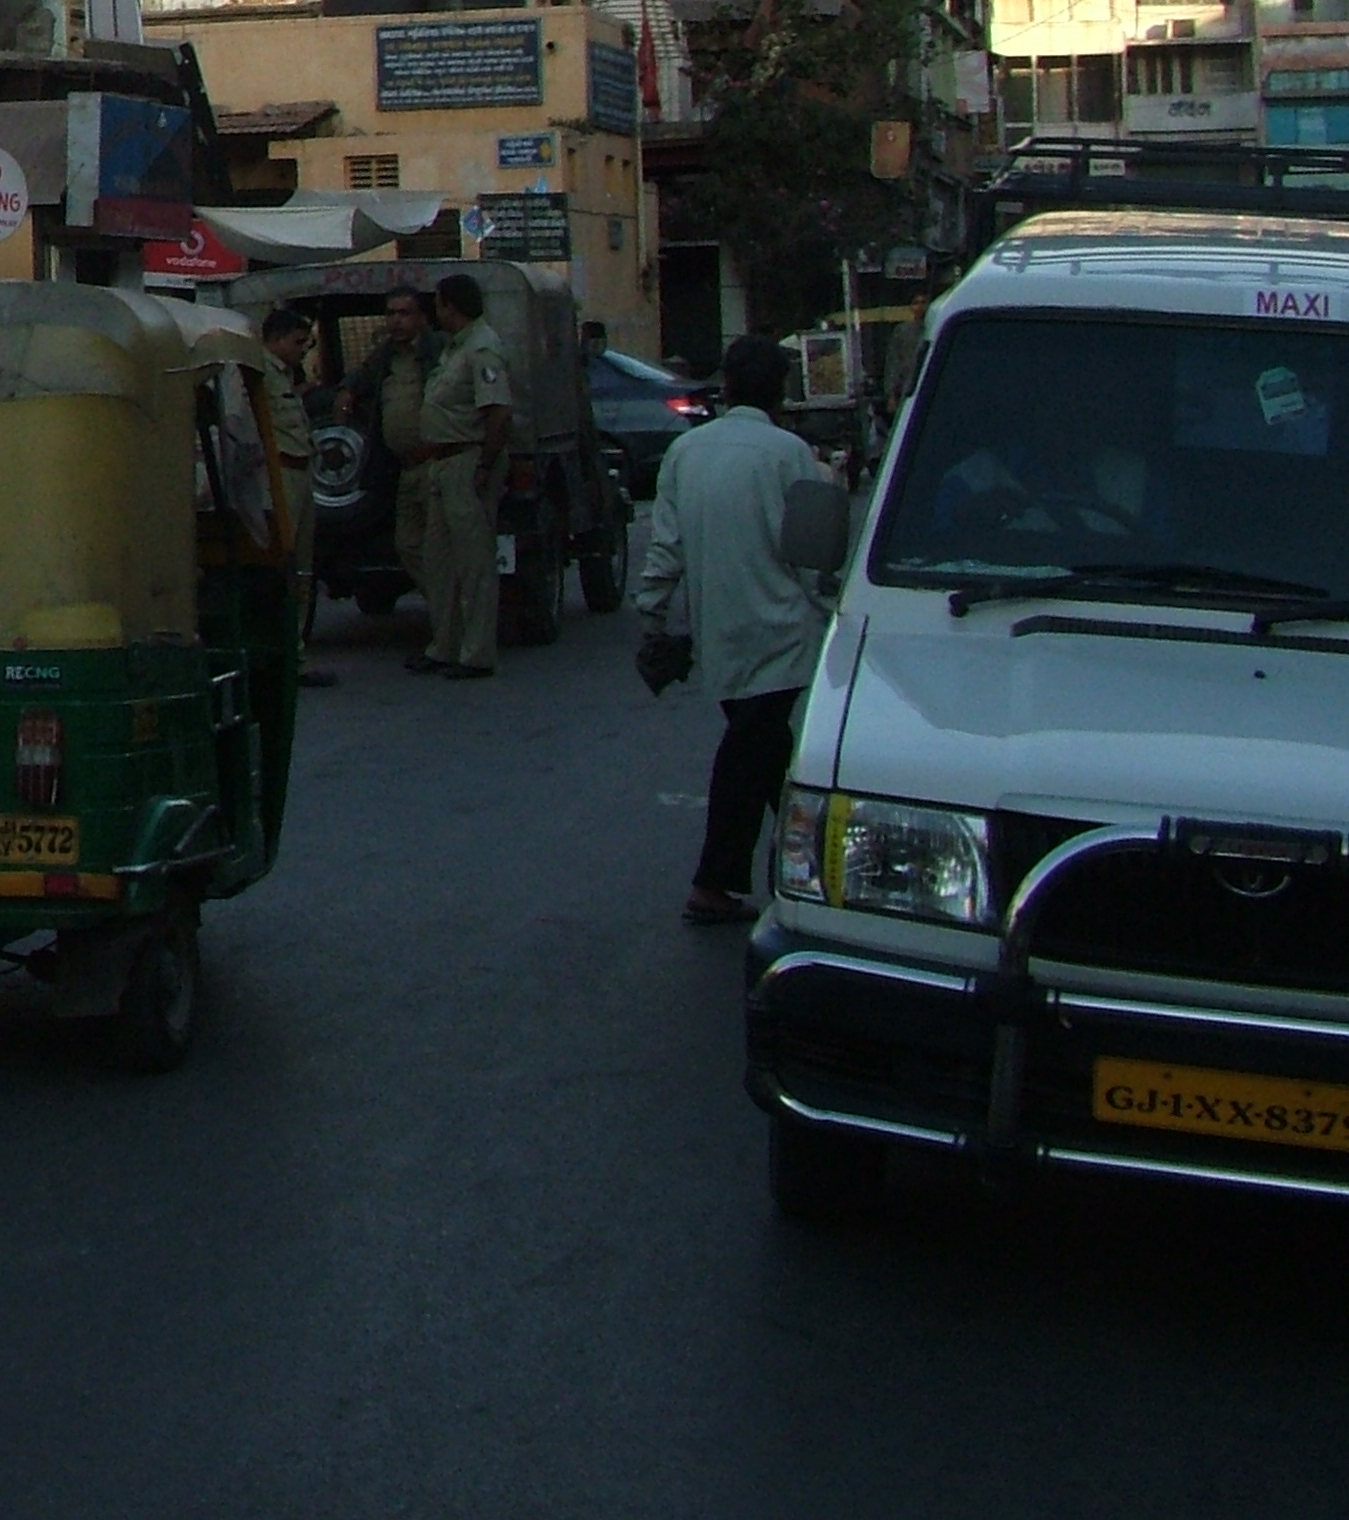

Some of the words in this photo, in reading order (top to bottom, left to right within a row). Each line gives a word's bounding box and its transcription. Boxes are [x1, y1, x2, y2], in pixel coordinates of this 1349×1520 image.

[165, 255, 217, 269] vodafone
[1257, 290, 1329, 318] MAXI
[18, 824, 74, 854] 5772
